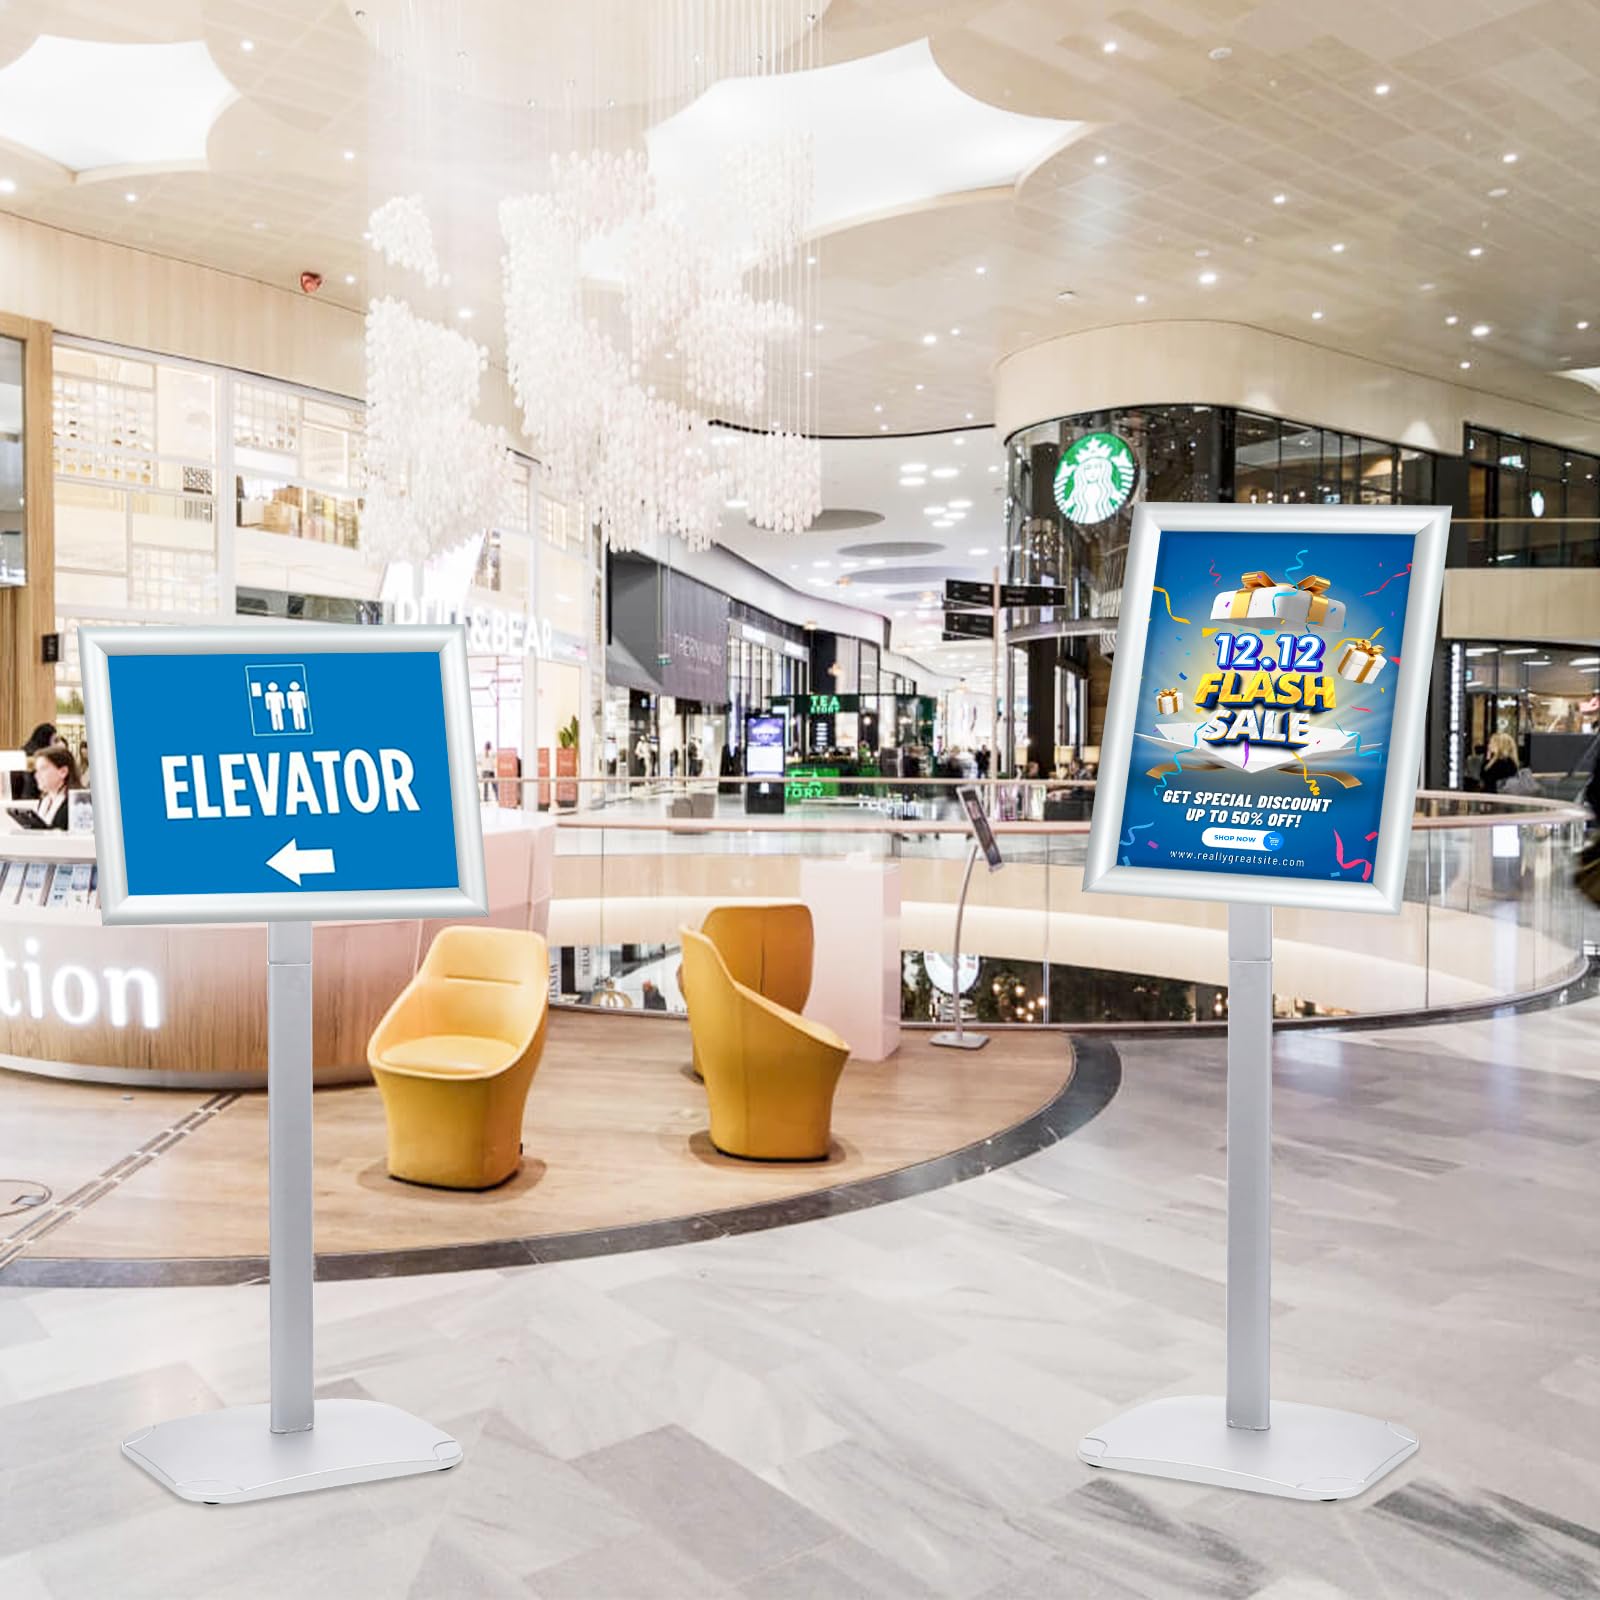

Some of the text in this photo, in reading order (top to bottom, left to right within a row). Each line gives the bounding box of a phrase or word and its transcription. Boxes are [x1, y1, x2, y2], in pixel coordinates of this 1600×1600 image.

[1215, 632, 1326, 672] 12.12
[810, 695, 840, 706] TEA
[1193, 672, 1337, 713] FLASH
[1202, 709, 1312, 749] SALE
[161, 748, 421, 820] ELEVATOR
[1162, 789, 1333, 813] GET SPECIAL DISCOUNT
[1185, 808, 1303, 829] UP TO 50% OFF!
[1213, 834, 1235, 842] SHOP
[1169, 850, 1306, 868] www.reallygreatsite.com
[0, 937, 161, 1029] tion
